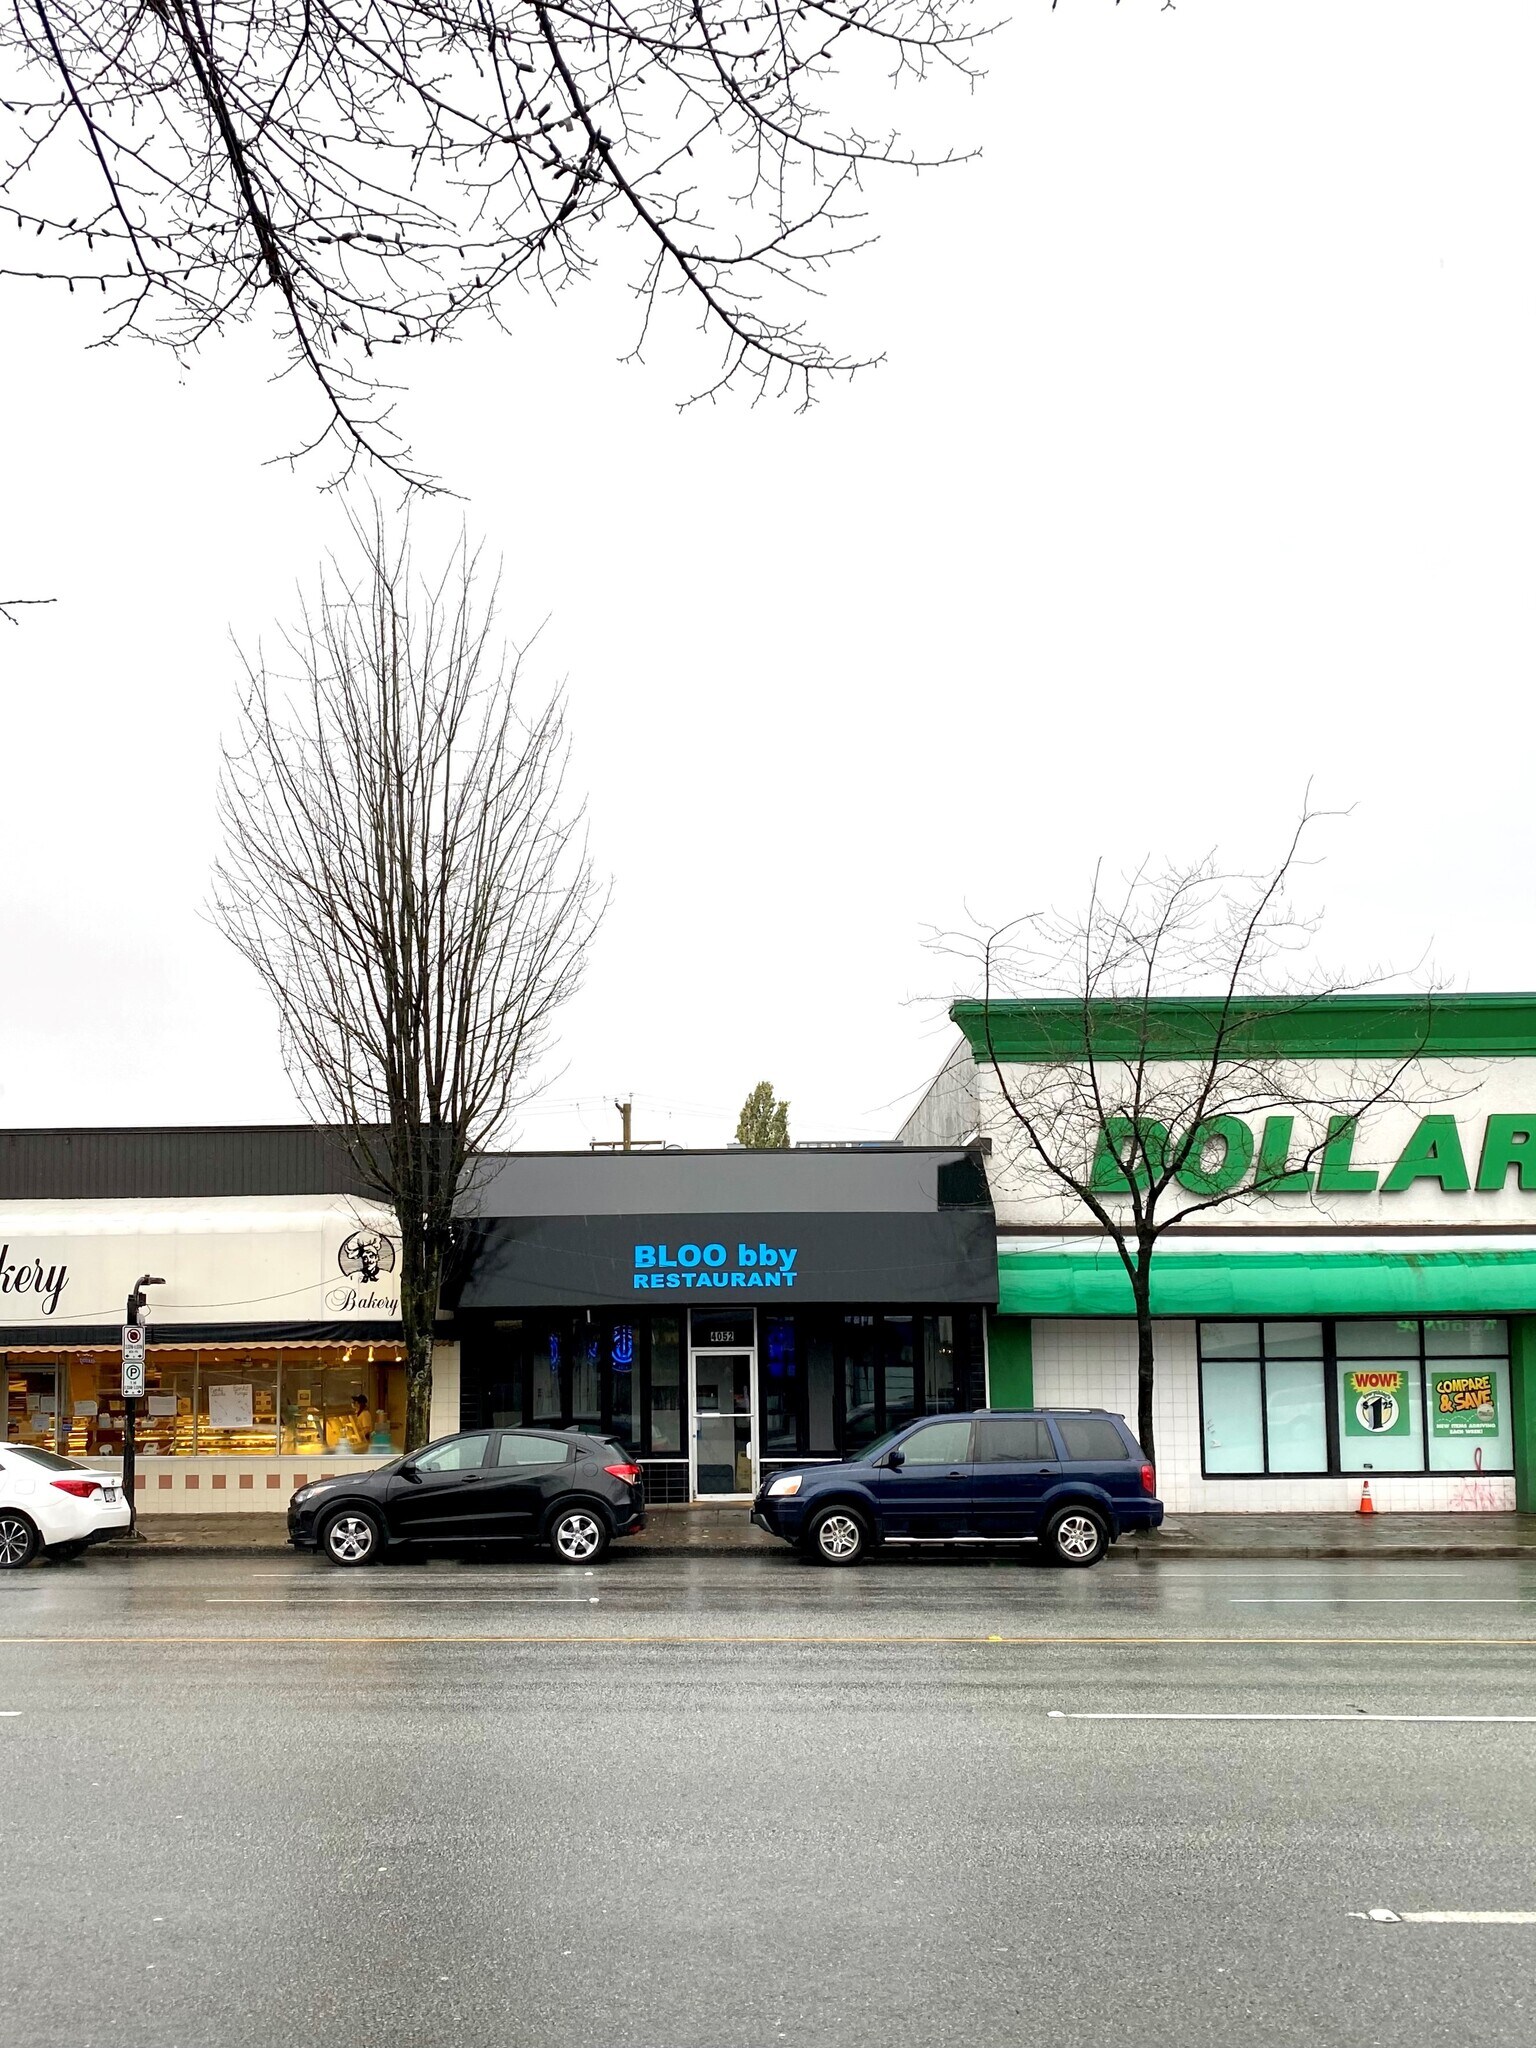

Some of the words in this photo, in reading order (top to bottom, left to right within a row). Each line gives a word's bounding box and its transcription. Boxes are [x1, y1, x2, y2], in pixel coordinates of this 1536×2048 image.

[1090, 1113, 1536, 1196] DOLLAR
[634, 1243, 728, 1268] BLOO
[738, 1243, 798, 1272] bby
[0, 1244, 70, 1315] kery
[633, 1272, 798, 1289] RESTAURANT
[325, 1286, 399, 1316] Bakery
[711, 1331, 735, 1341] 4052
[1354, 1373, 1398, 1388] WOW!
[1436, 1375, 1491, 1394] COMPARE
[1440, 1393, 1454, 1412] &
[1453, 1389, 1493, 1411] SAVE
